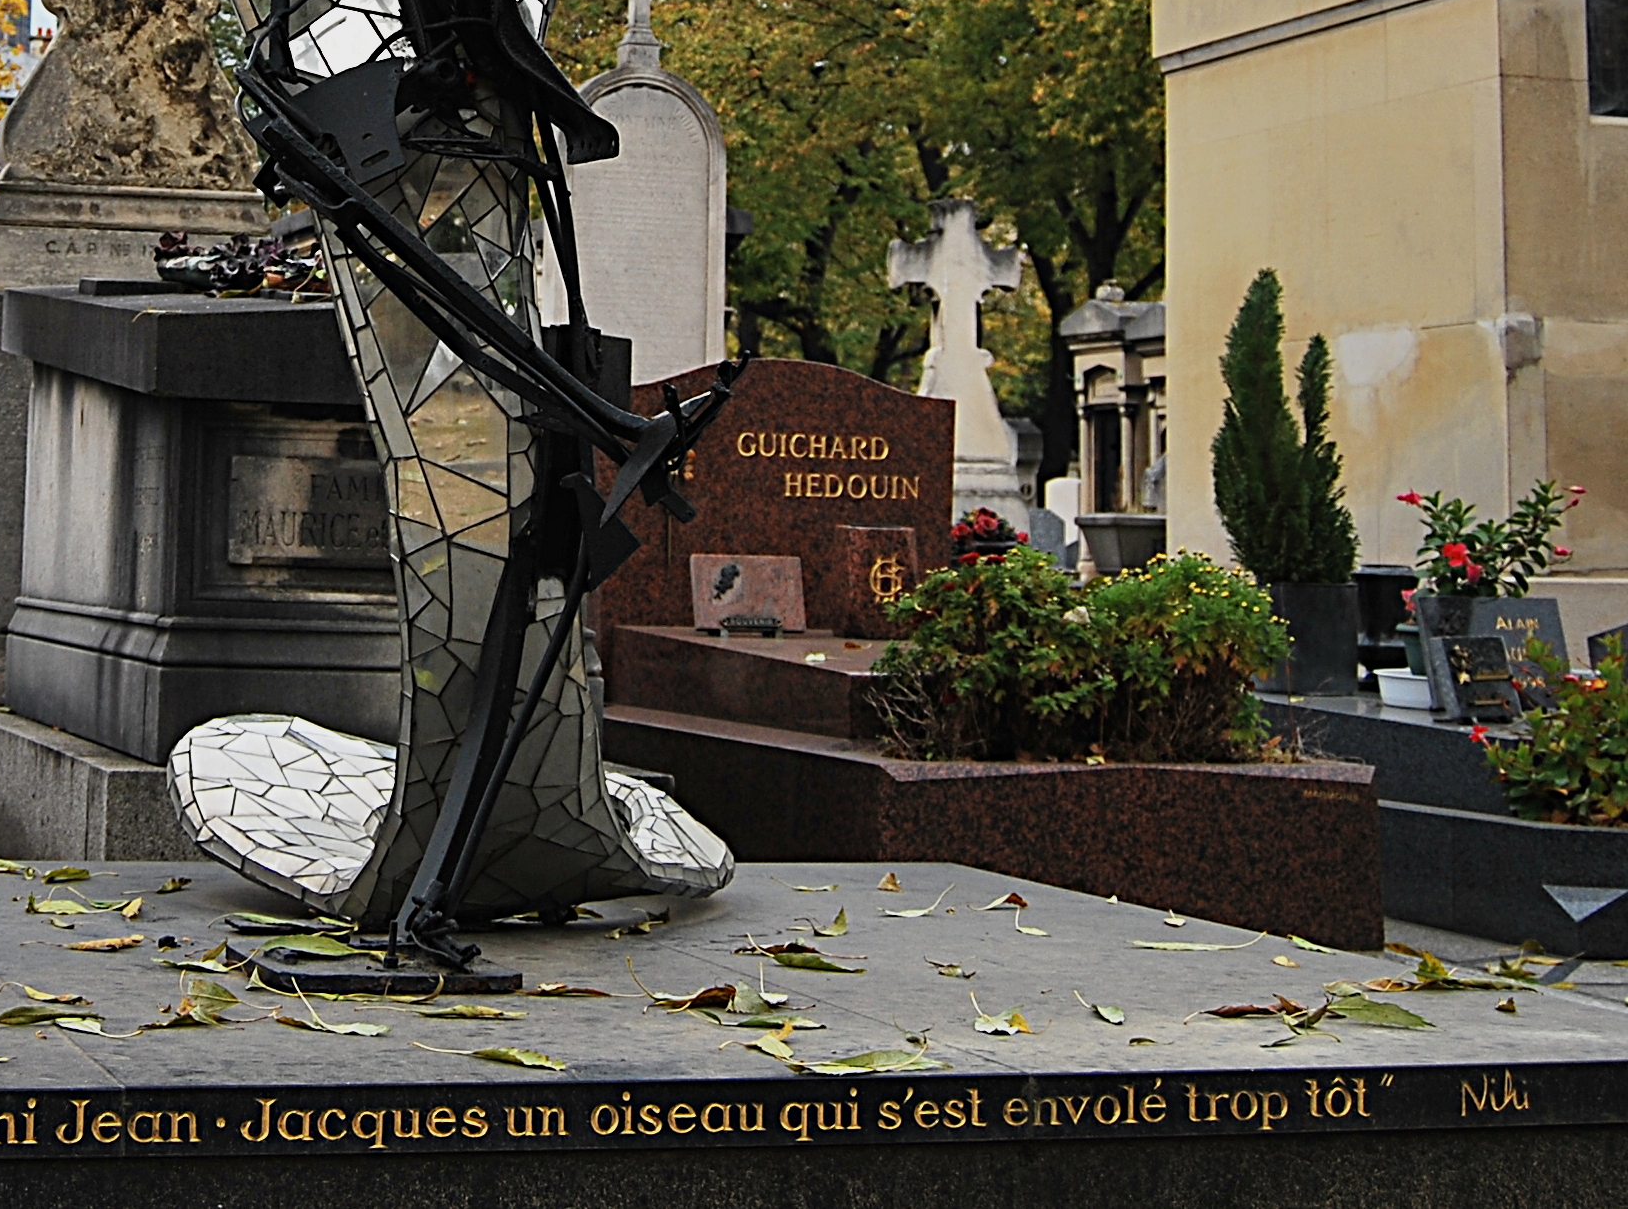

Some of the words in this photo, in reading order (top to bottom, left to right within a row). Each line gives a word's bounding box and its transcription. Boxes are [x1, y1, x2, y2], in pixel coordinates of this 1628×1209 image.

[737, 431, 890, 461] GUICHARD
[783, 471, 921, 500] HEDOUIN
[239, 510, 360, 550] MAURICE
[505, 1106, 570, 1138] un
[589, 1091, 766, 1137] oiseau
[779, 1086, 862, 1143] qui
[1003, 1077, 1168, 1129] envolé
[1187, 1081, 1289, 1132] trop
